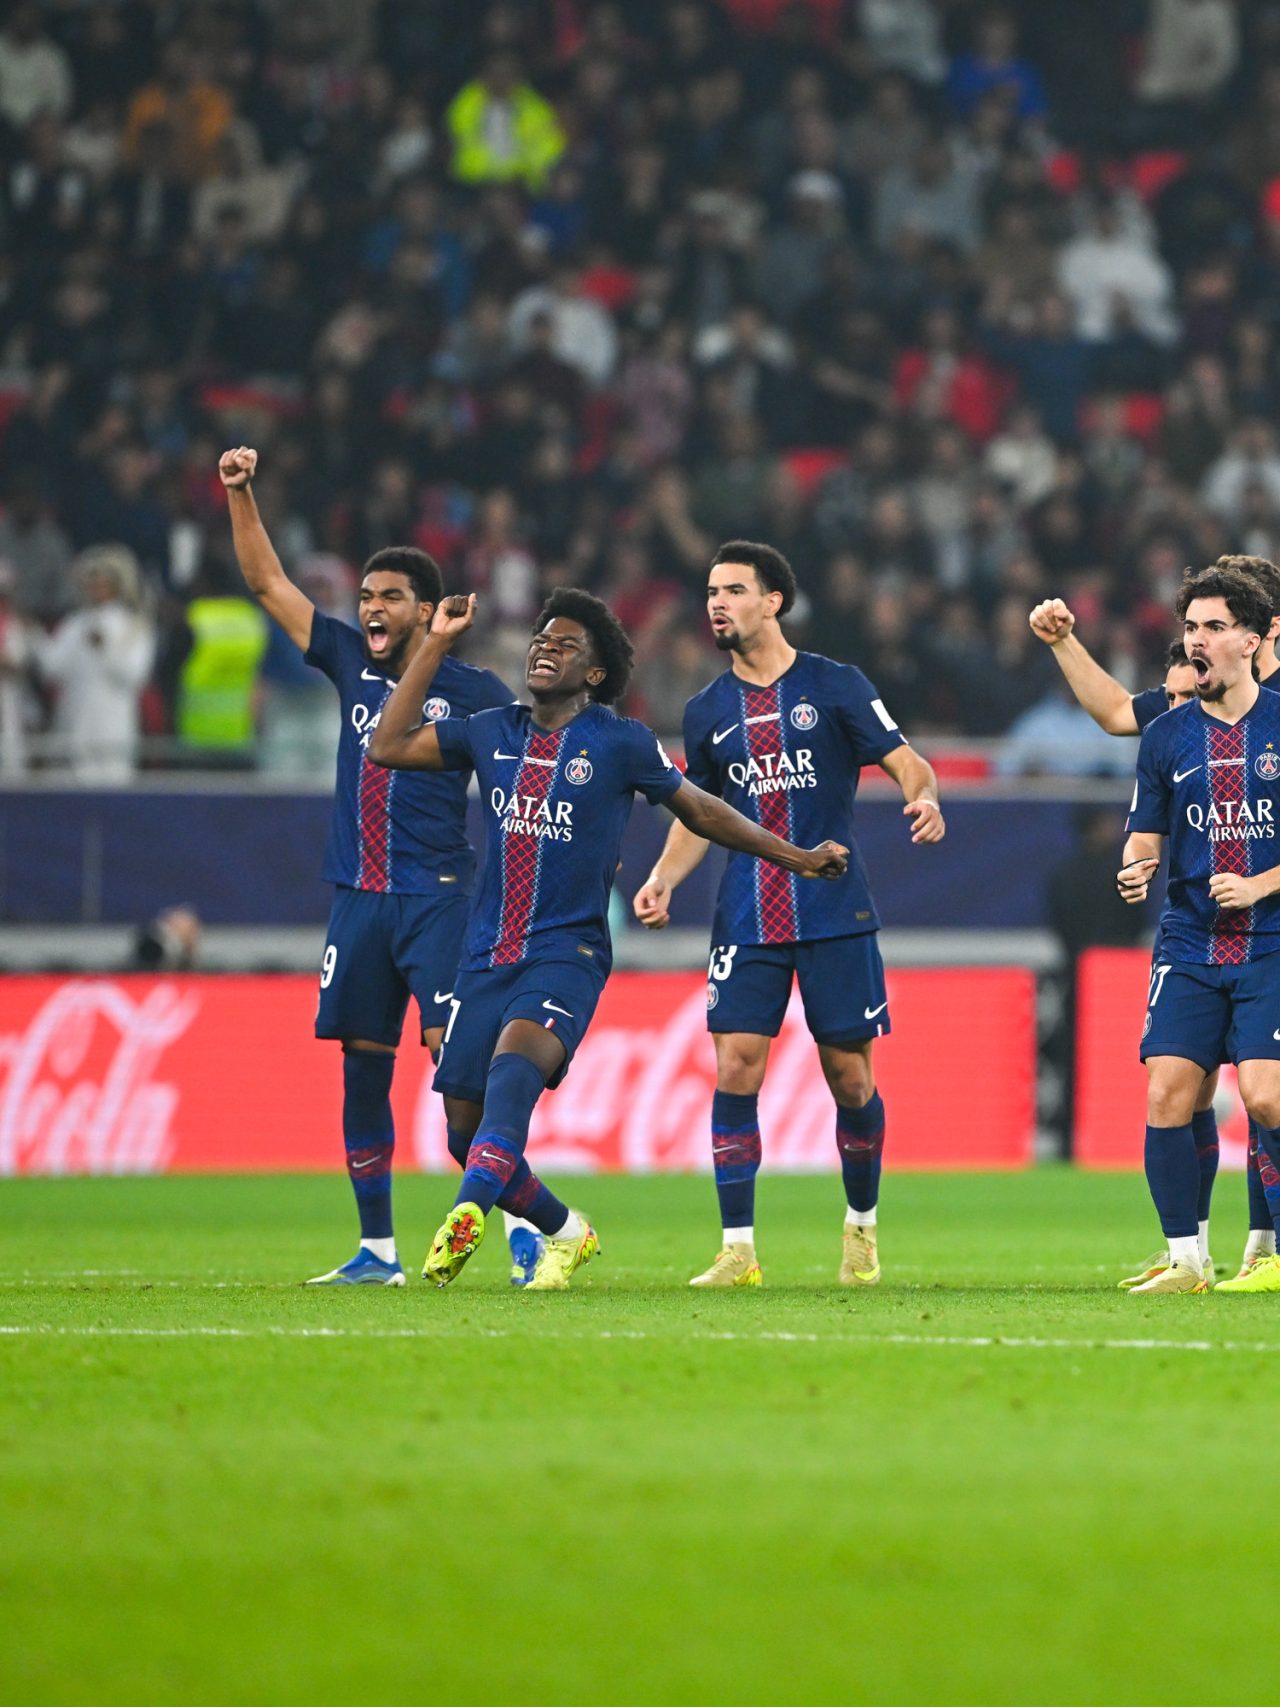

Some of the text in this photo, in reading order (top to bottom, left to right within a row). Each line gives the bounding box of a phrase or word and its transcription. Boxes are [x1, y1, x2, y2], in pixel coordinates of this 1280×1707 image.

[728, 749, 814, 787] QATAR
[748, 773, 817, 797] AIRWAYS
[491, 788, 573, 825] QATAR
[1186, 799, 1274, 832] QATAR
[500, 817, 572, 842] AIRWAYS
[1208, 823, 1275, 842] AIRWAYS
[320, 945, 338, 989] 9
